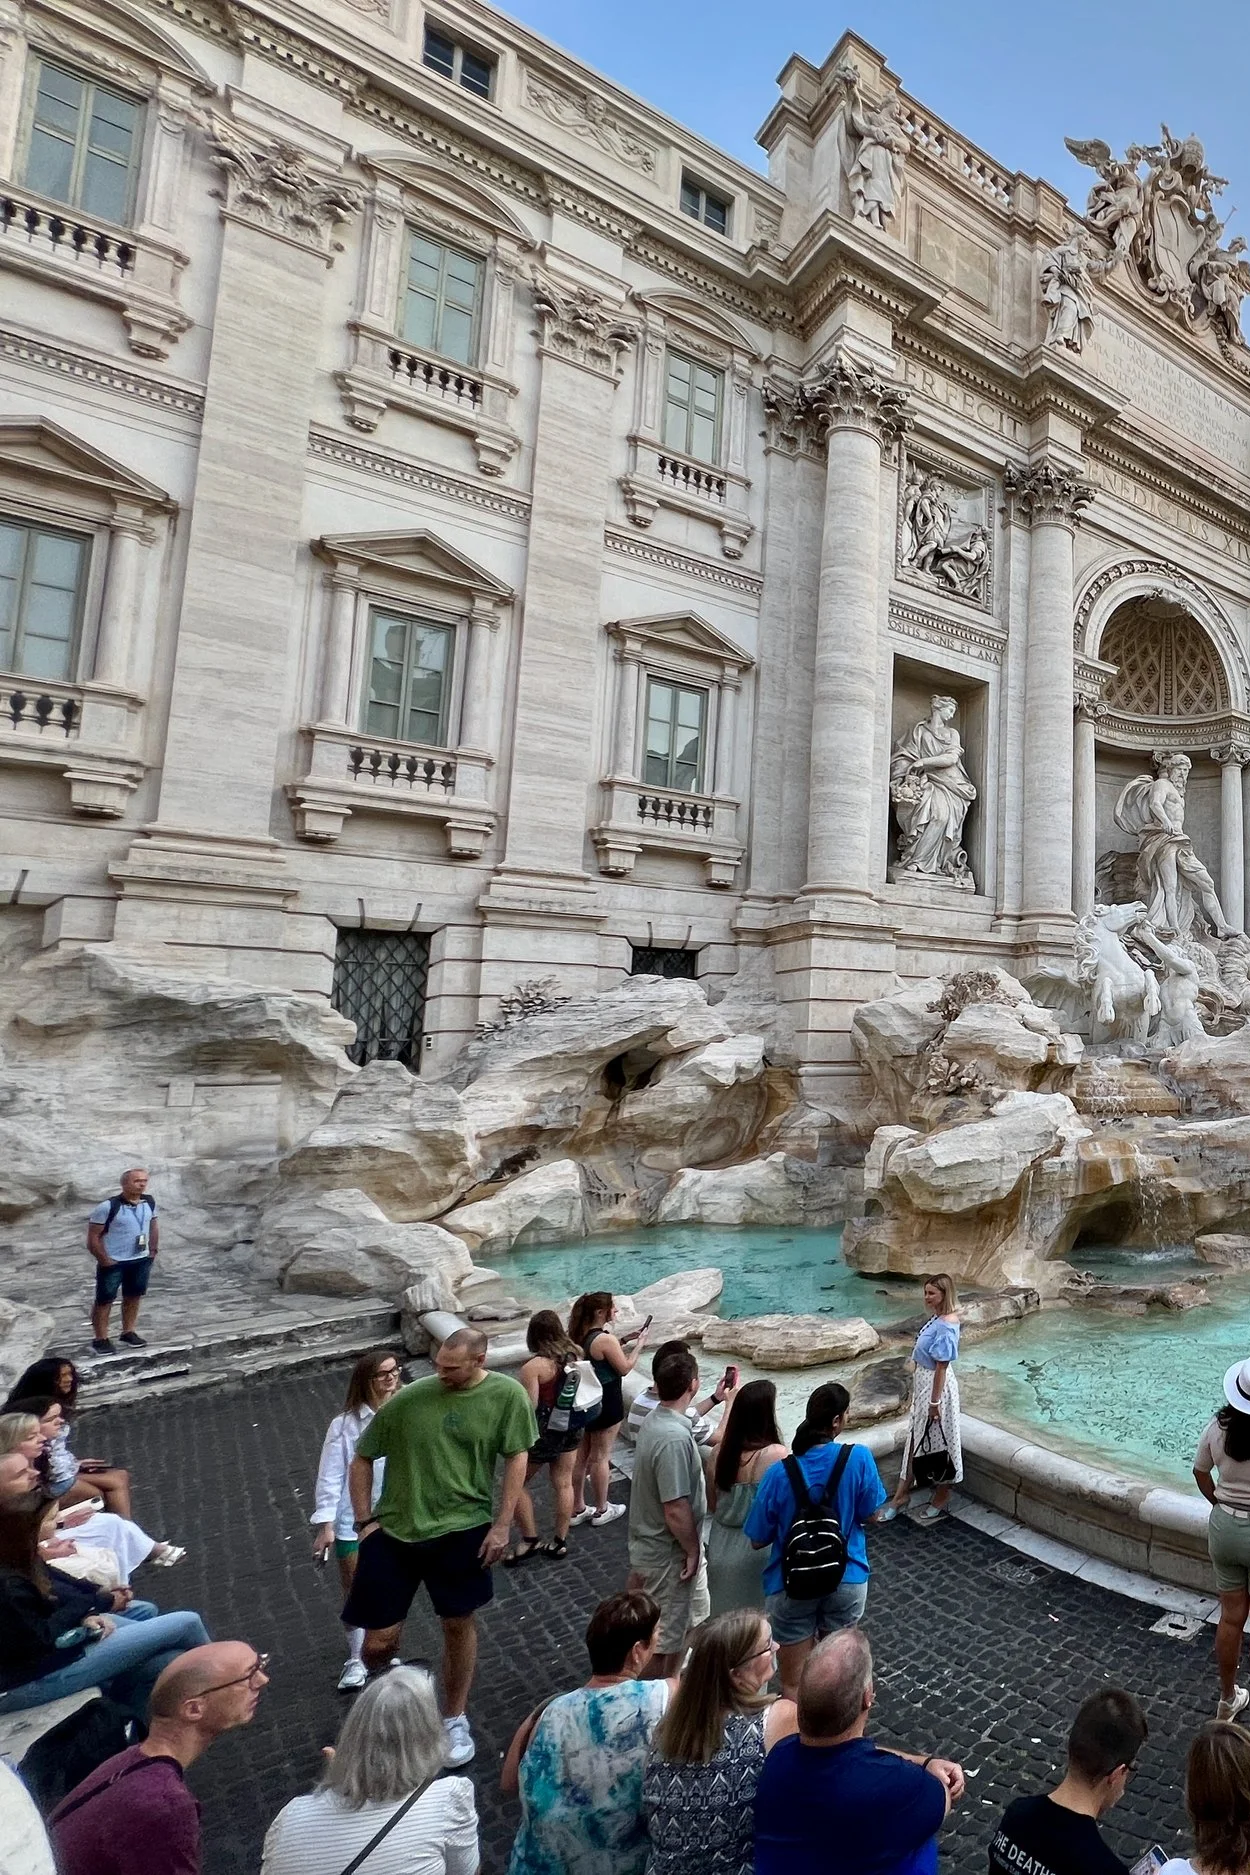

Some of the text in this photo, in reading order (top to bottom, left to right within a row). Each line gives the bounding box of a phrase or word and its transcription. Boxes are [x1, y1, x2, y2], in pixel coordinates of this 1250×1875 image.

[1085, 336, 1110, 359] OPIA
[1094, 314, 1147, 359] CLEMENS
[904, 360, 1022, 439] ERFECIT
[1089, 461, 1208, 541] ENEDICTVS
[889, 619, 921, 637] OSITIS
[924, 632, 955, 649] SIGNIS
[961, 642, 971, 655] ET
[1007, 1843, 1057, 1875] DEATH
